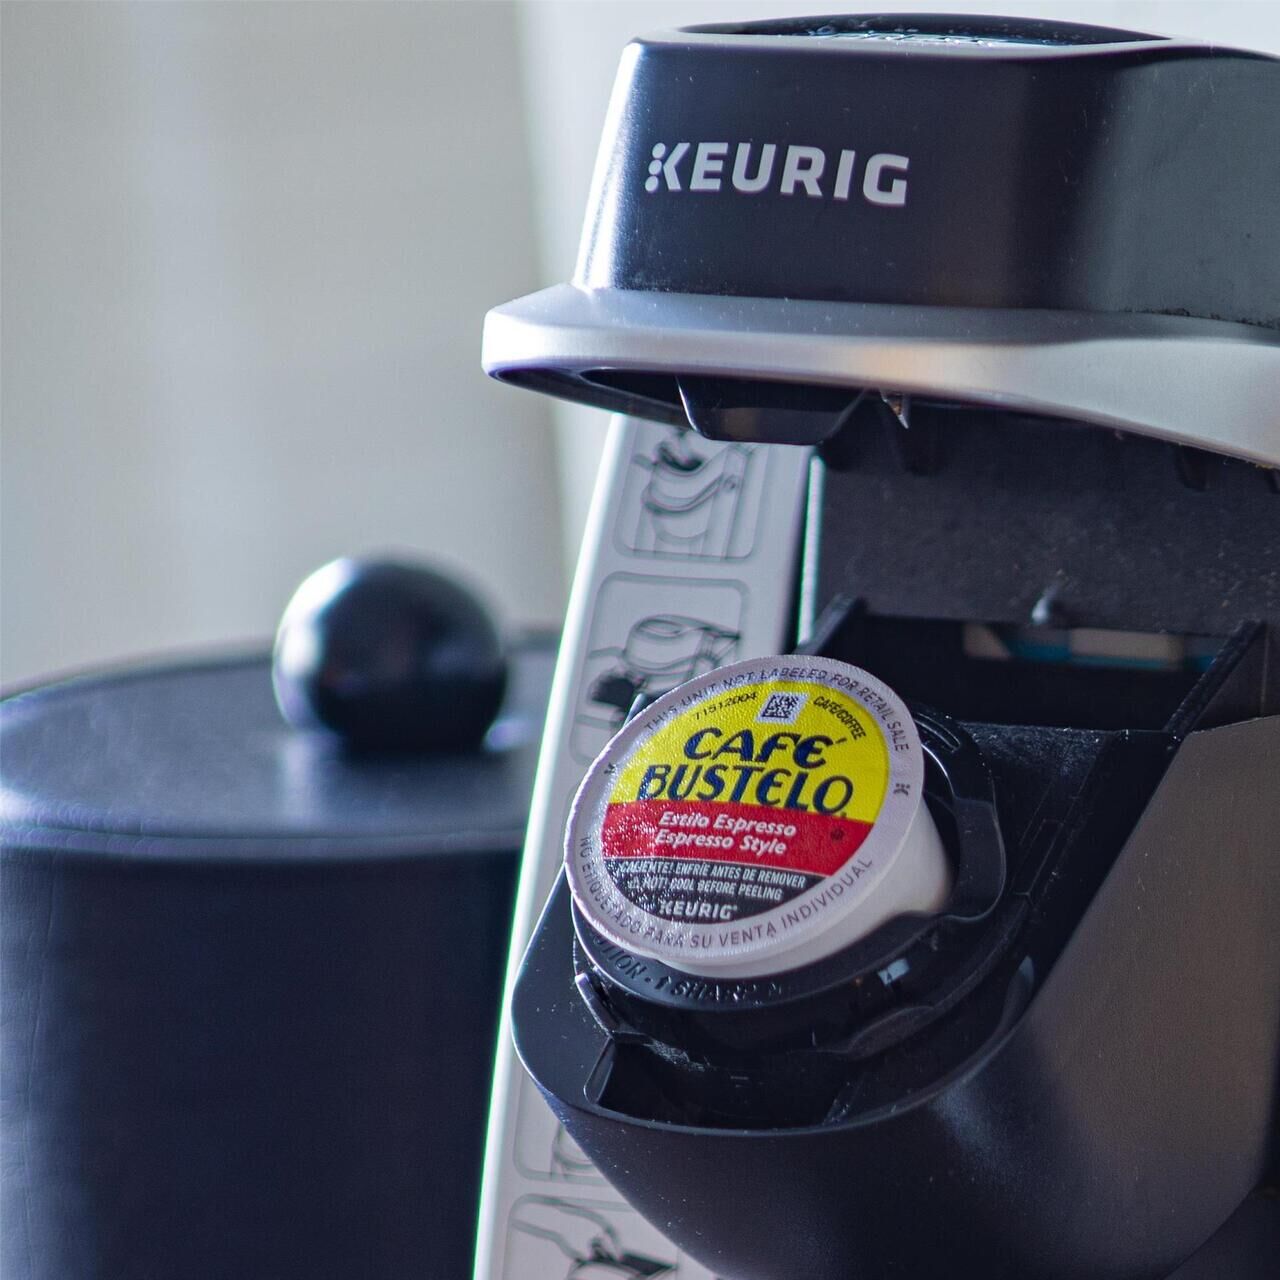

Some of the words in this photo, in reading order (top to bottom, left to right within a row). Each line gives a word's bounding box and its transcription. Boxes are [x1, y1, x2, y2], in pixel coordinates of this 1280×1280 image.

[644, 141, 910, 207] KEURIG
[760, 667, 827, 681] LABELED
[831, 673, 858, 694] FOR
[858, 686, 897, 720] RETAIL
[887, 720, 910, 752] SALE
[683, 726, 848, 769] CAFÉ
[636, 763, 854, 816] BUSTELO
[658, 811, 710, 828] Estilo
[713, 814, 797, 837] Espresso
[655, 829, 734, 849] Espresso
[739, 835, 787, 856] Style
[697, 879, 737, 897] BEFORE
[738, 883, 783, 901] PEELING
[710, 863, 742, 880] ANTES
[742, 867, 758, 881] DE
[757, 869, 806, 889] REMOVER
[659, 898, 734, 920] KEURIG
[690, 934, 712, 950] SU
[719, 921, 777, 947] VENTA
[780, 856, 873, 930] INDIVIDUAL
